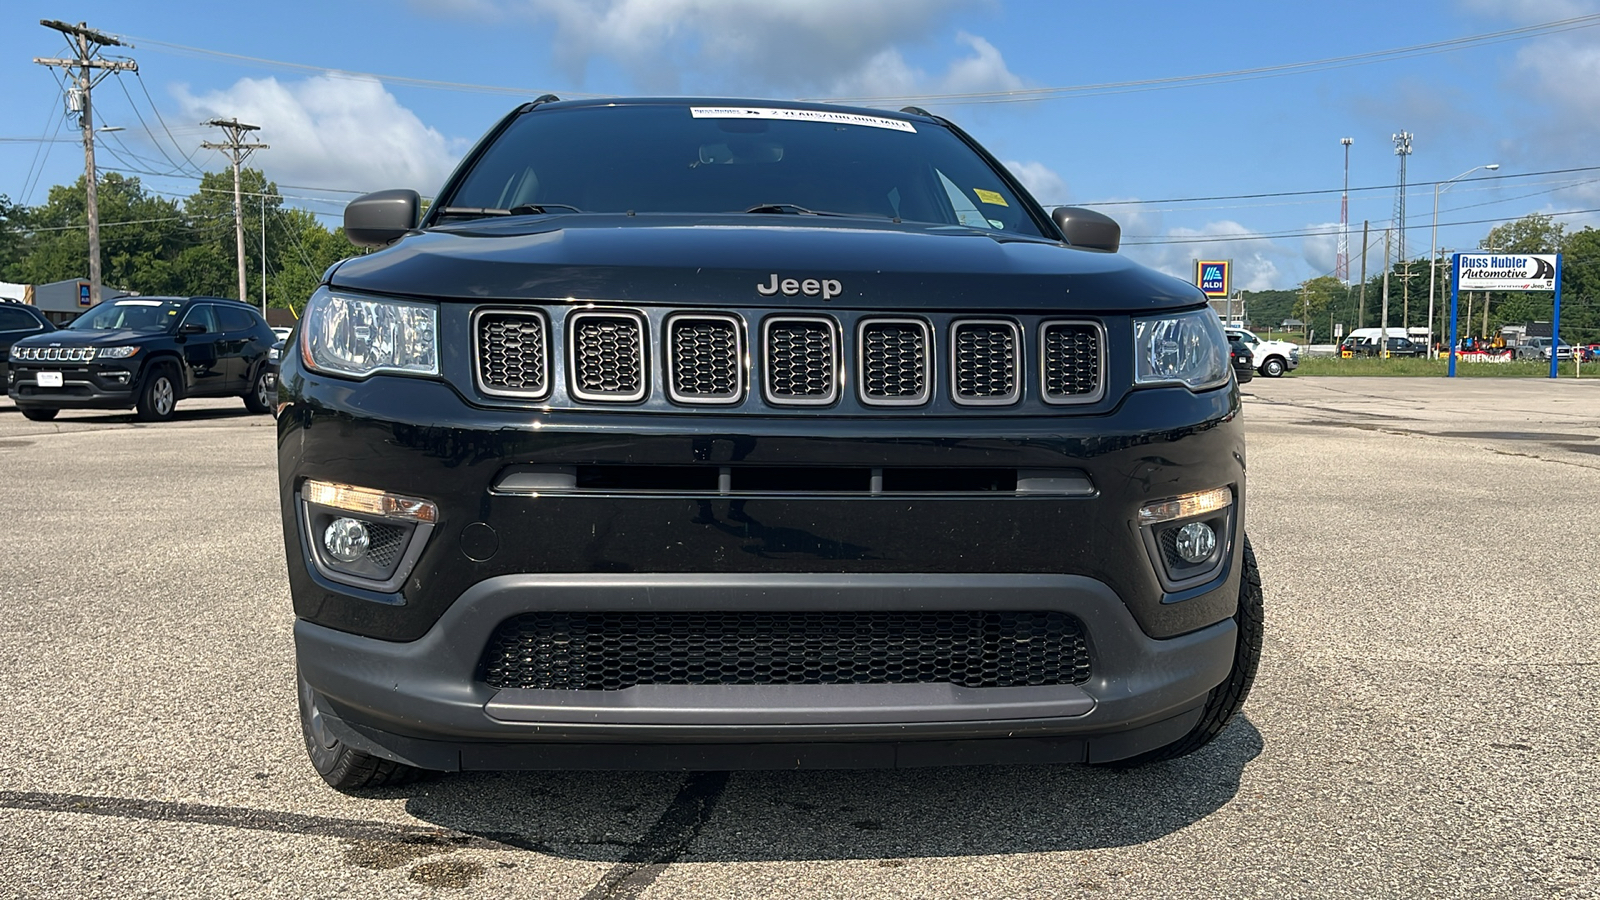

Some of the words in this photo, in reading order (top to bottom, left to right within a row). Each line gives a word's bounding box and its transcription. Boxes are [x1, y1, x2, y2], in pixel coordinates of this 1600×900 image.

[1461, 256, 1488, 268] Russ
[1491, 256, 1527, 268] Hubler
[1461, 268, 1527, 279] Automotive
[757, 273, 842, 300] Jeep
[1203, 281, 1222, 289] ALDI
